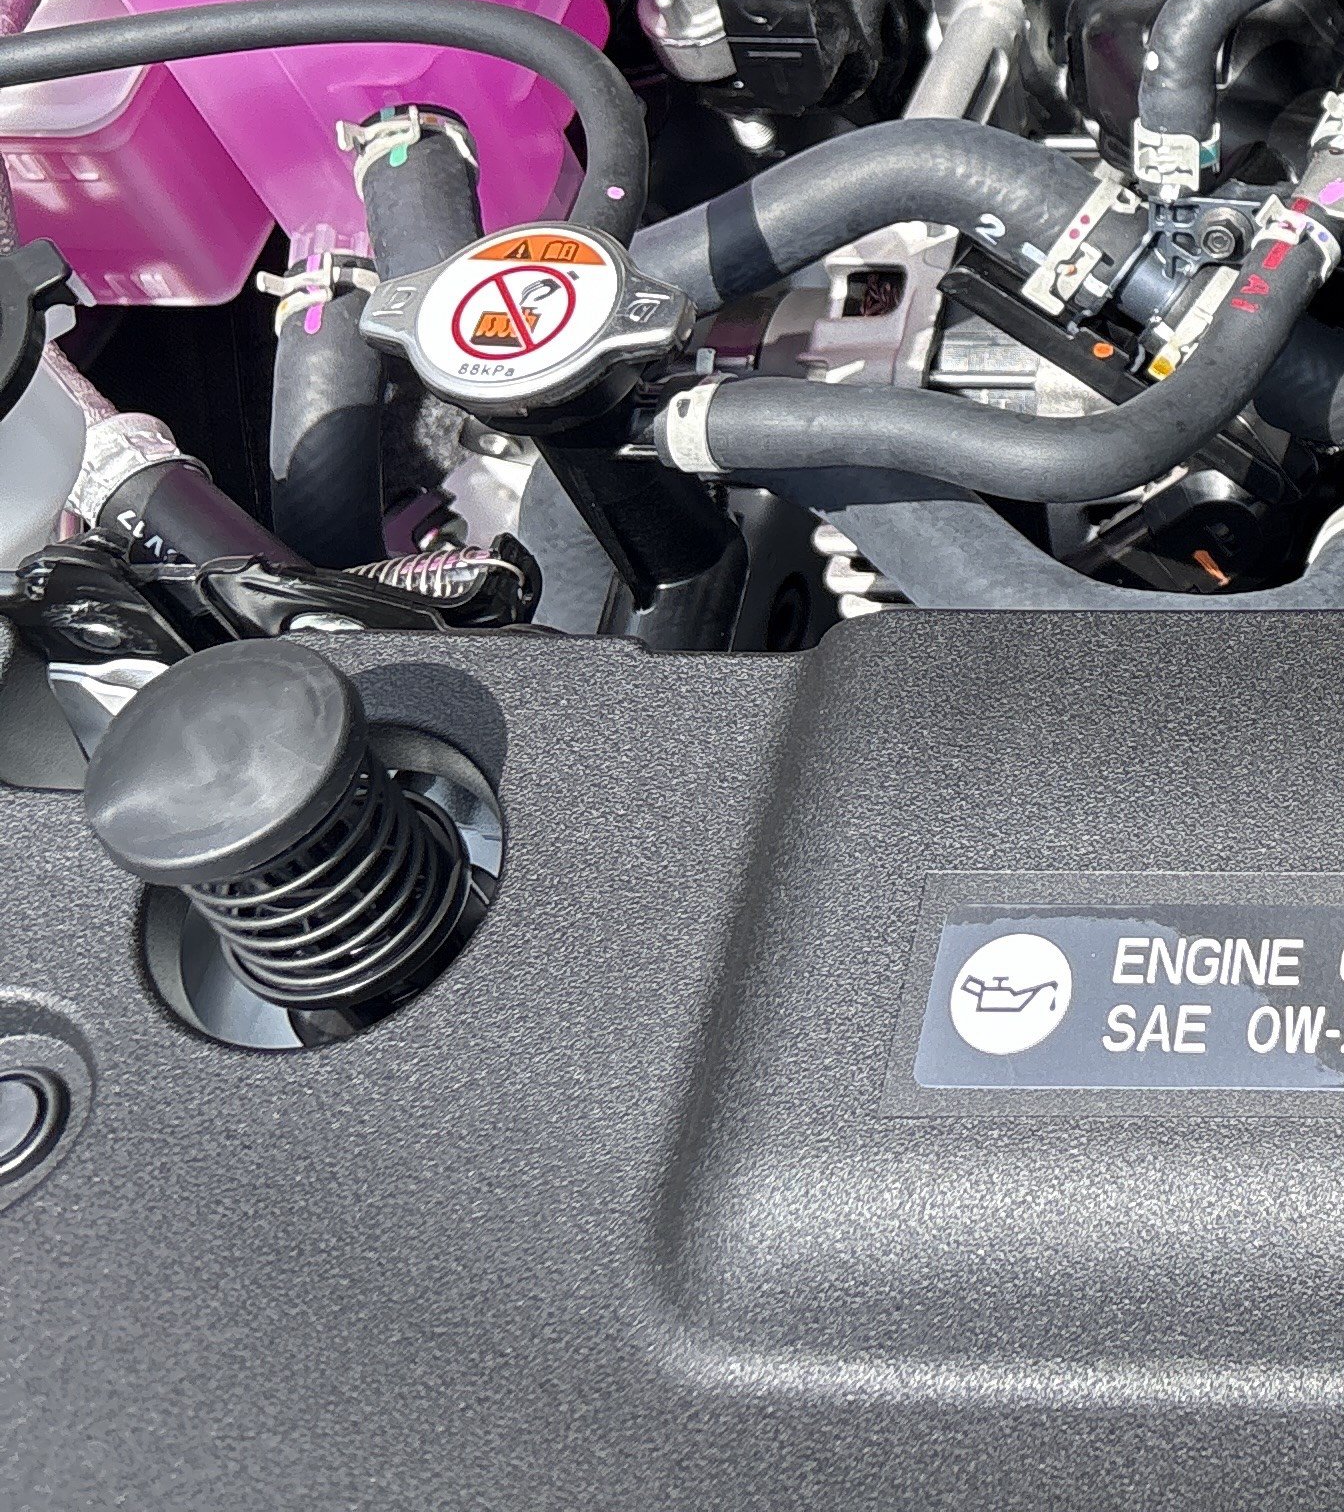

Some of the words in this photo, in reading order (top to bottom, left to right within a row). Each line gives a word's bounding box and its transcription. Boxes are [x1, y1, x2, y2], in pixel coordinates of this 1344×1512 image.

[974, 212, 1006, 246] 2
[457, 363, 516, 378] 88kPa
[1112, 936, 1306, 988] ENGINE
[1101, 1005, 1214, 1055] SAE
